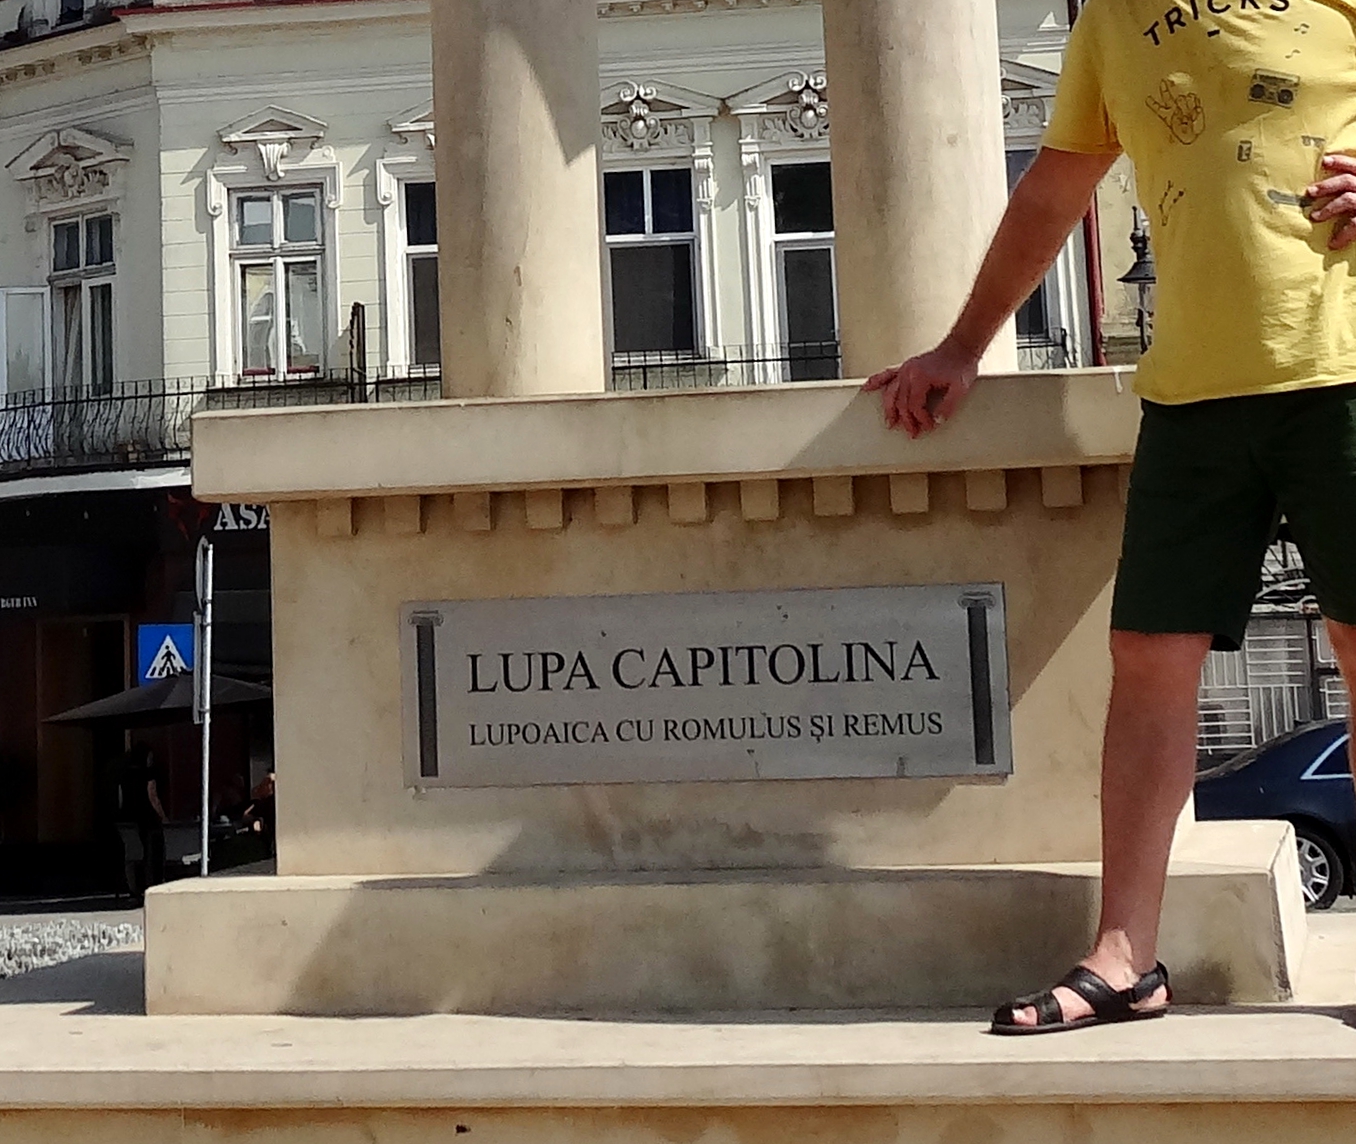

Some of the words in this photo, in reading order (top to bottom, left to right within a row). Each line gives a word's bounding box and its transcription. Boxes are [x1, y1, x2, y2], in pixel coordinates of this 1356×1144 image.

[466, 650, 601, 694] LUPA
[611, 640, 941, 690] CAPITOLINA
[468, 721, 610, 747] LUPOAICA
[615, 719, 654, 743] CU
[662, 715, 802, 742] ROMULUS
[842, 712, 943, 738] REMUS
